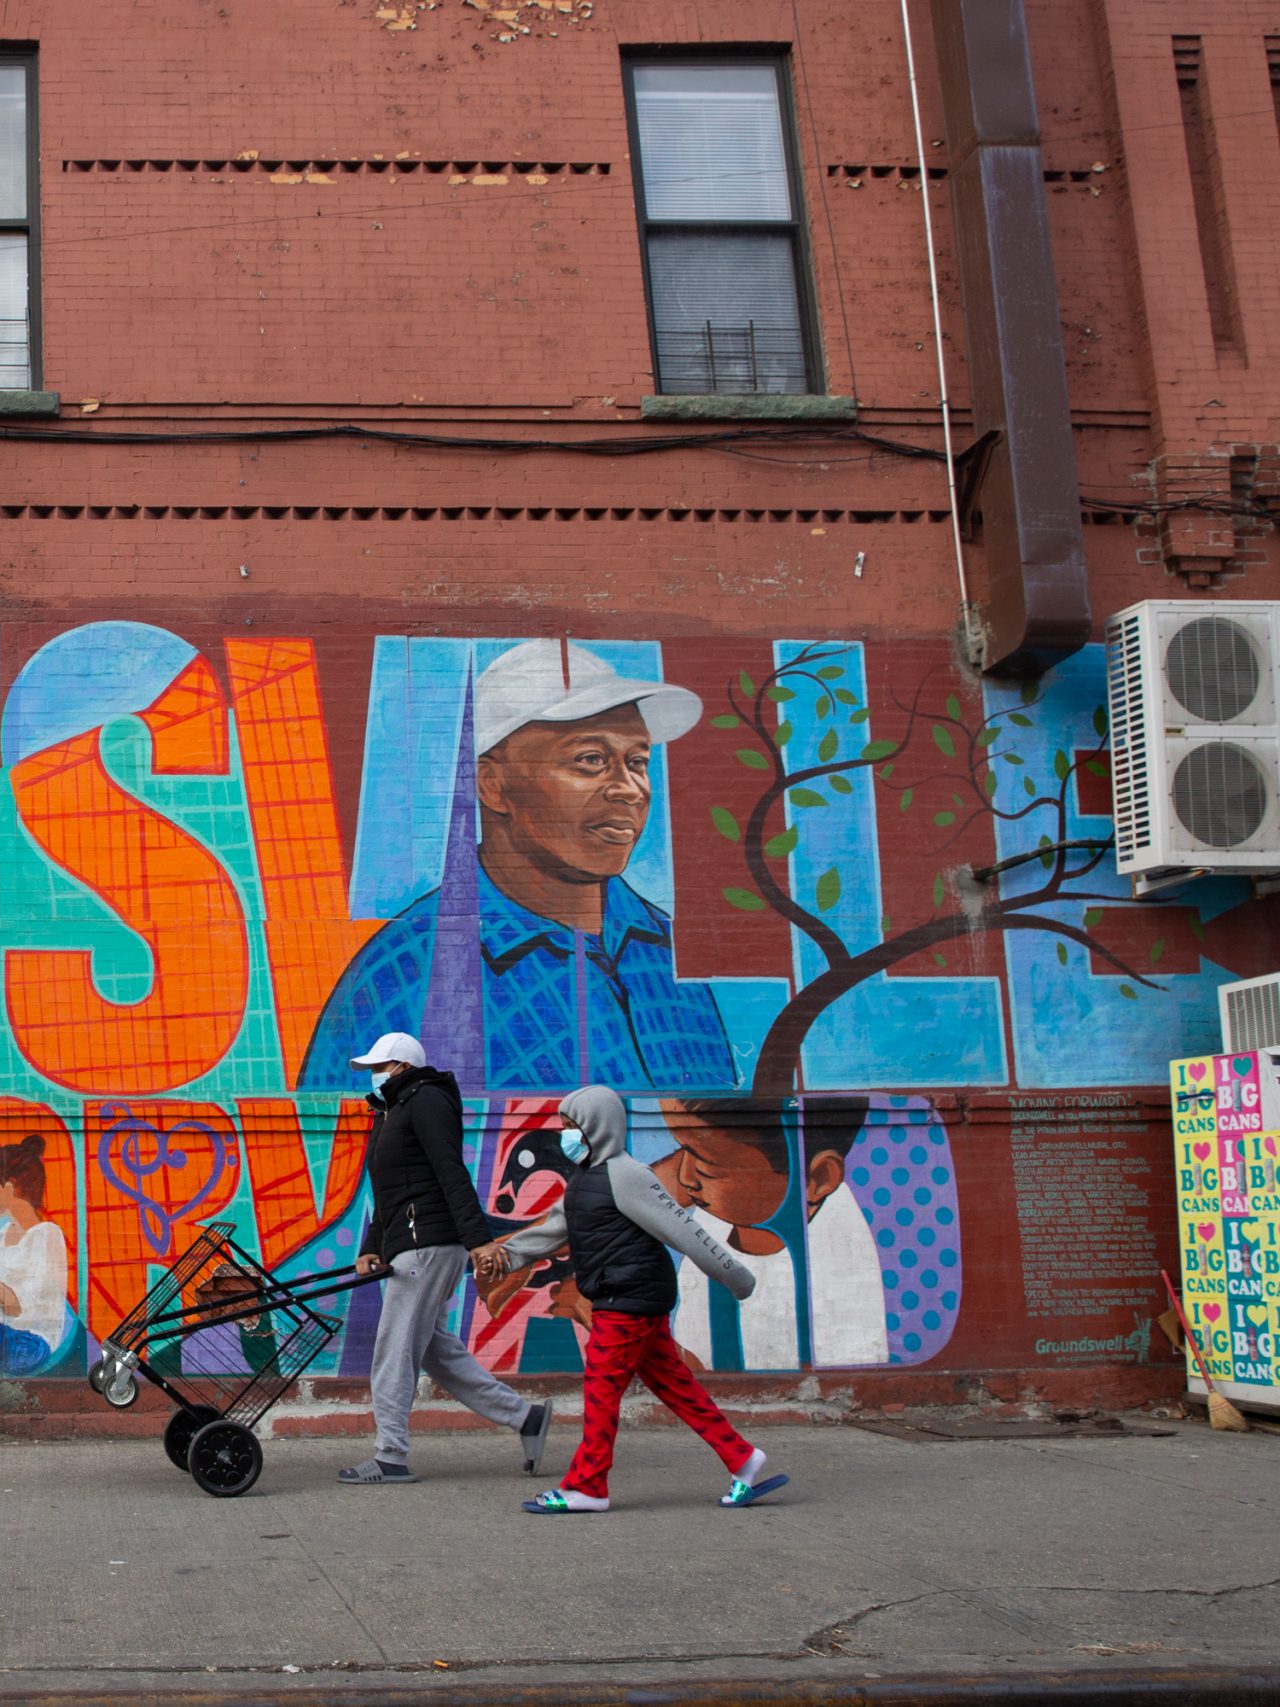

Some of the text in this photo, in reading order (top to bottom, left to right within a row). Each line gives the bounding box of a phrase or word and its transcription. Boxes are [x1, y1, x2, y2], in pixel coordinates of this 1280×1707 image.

[1177, 1117, 1216, 1134] CANS
[1218, 1113, 1261, 1131] CANS
[1182, 1198, 1220, 1213] CANS
[1251, 1195, 1280, 1211] CAN
[650, 1183, 734, 1270] PERRY ELLIS
[1186, 1278, 1225, 1294] CANS
[1228, 1279, 1262, 1297] CAN
[1035, 1335, 1123, 1354] Groundswell
